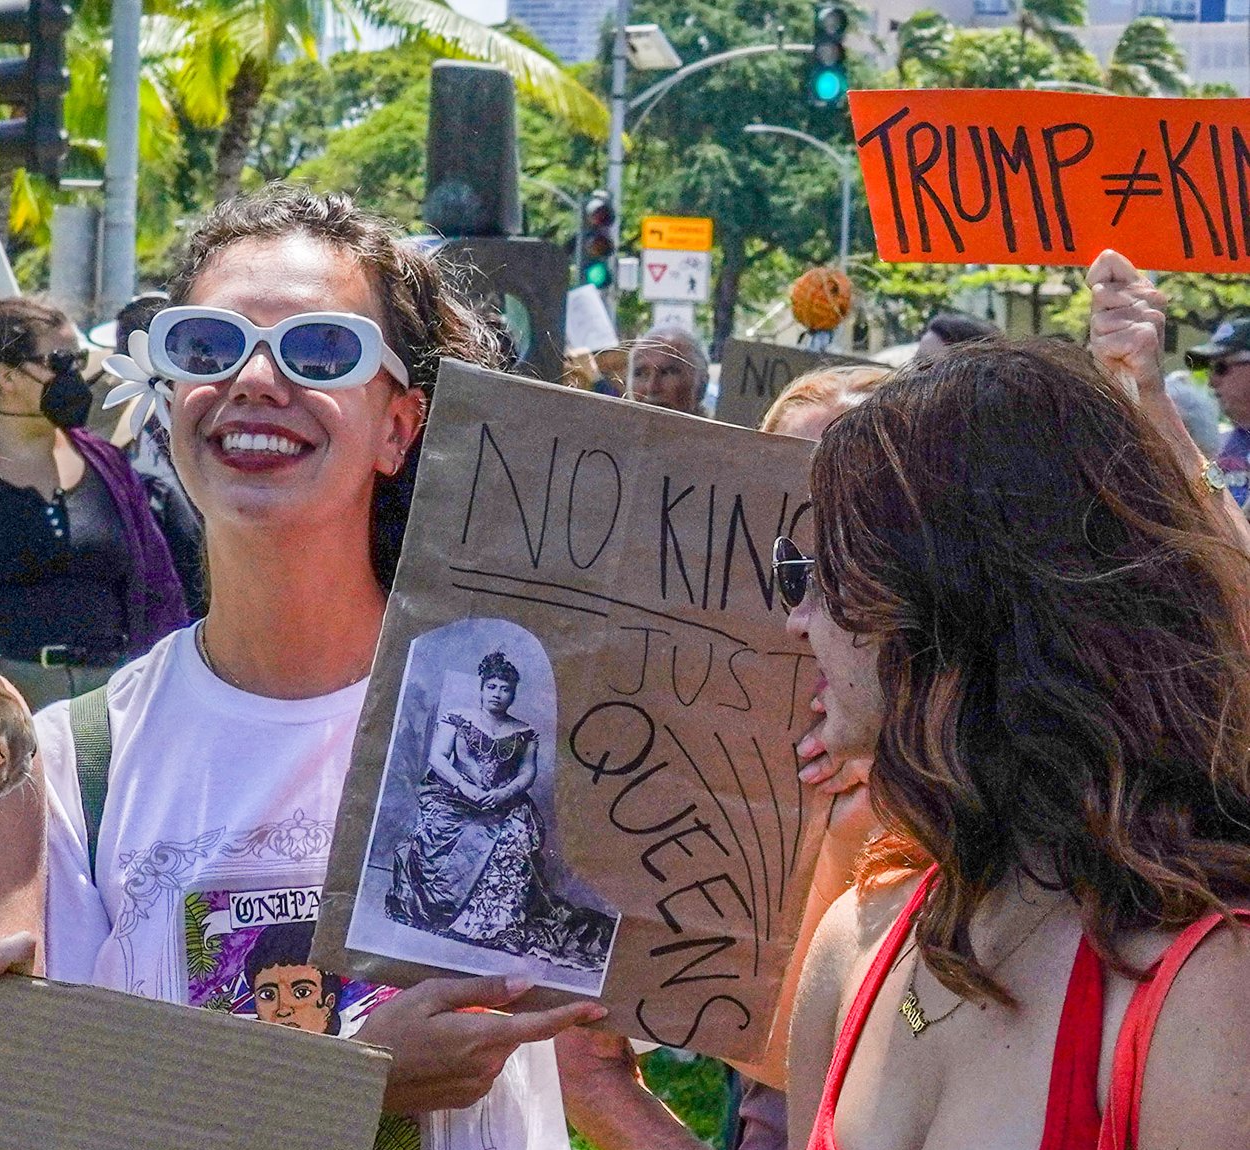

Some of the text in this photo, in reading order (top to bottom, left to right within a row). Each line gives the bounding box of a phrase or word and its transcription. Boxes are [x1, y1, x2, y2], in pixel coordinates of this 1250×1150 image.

[858, 106, 1095, 254] TRUMP
[462, 423, 622, 569] NO
[609, 626, 817, 731] JUST
[569, 701, 753, 1049] QUEENS
